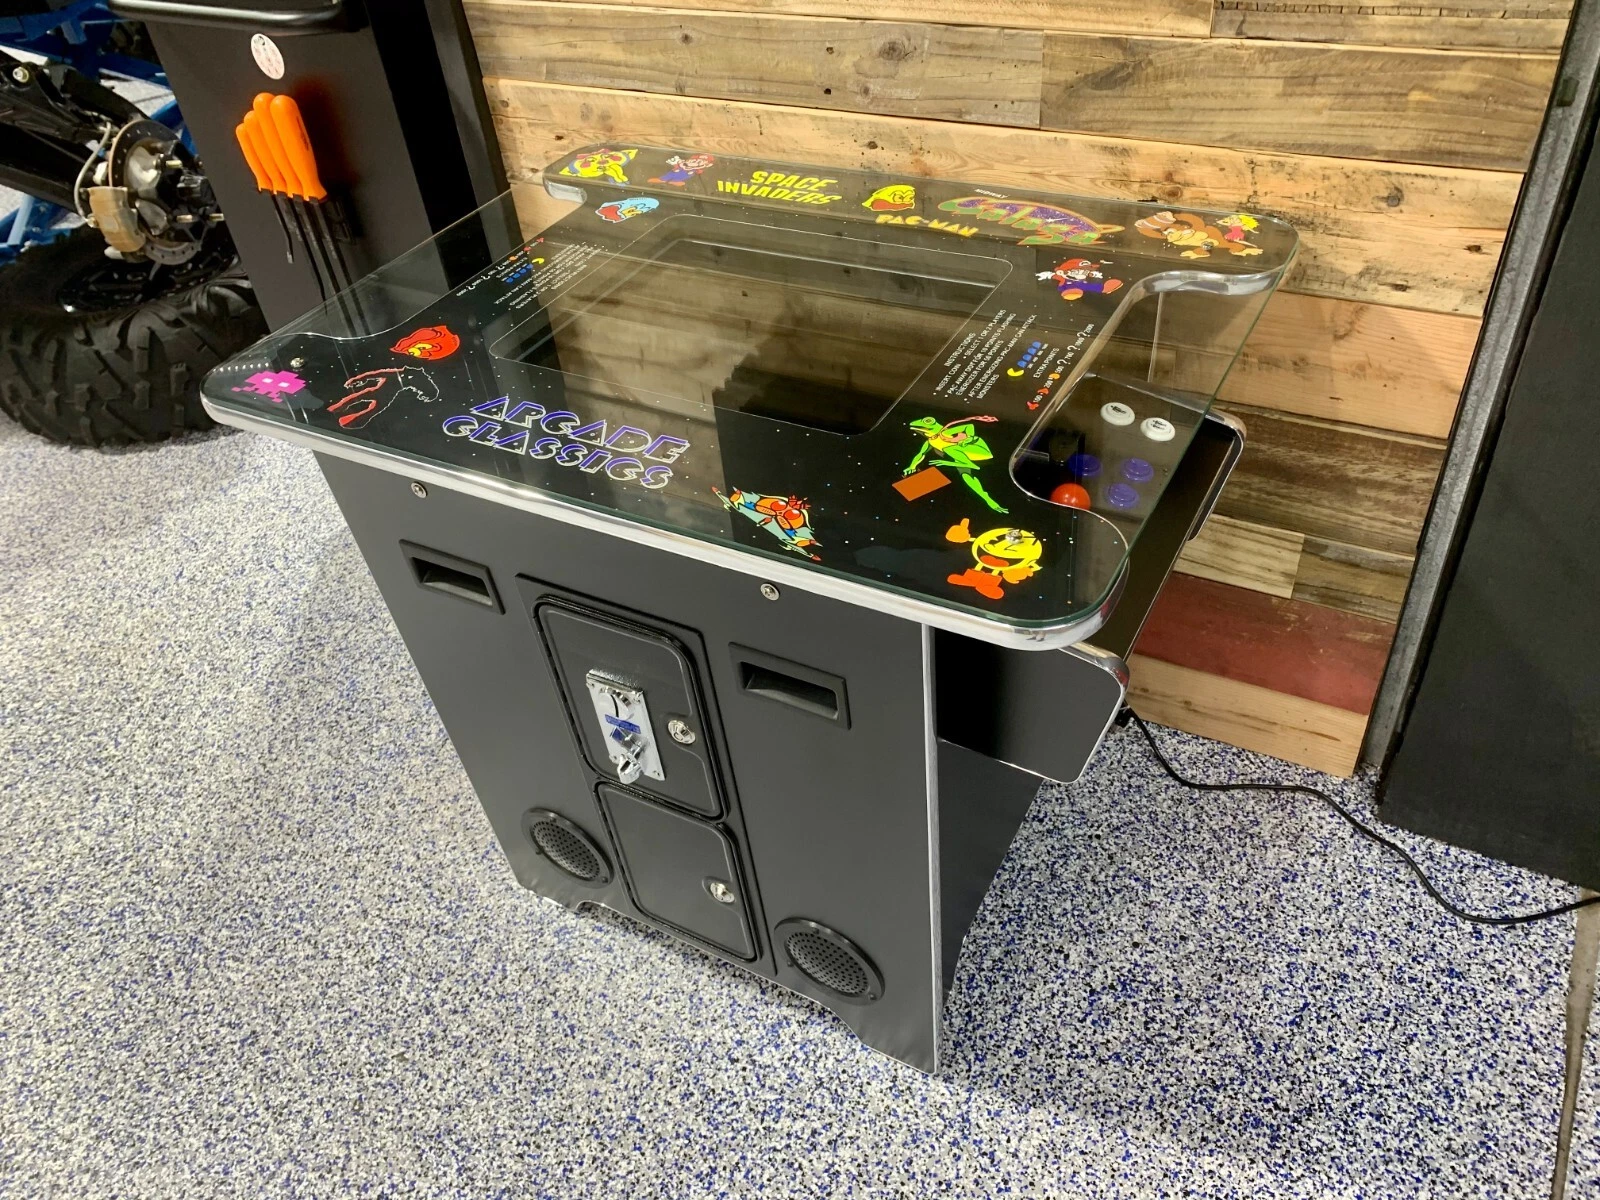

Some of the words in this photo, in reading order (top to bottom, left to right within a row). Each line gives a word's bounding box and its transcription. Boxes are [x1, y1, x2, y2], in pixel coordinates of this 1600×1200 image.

[717, 180, 842, 205] INVADERS
[750, 170, 838, 191] SPACE
[974, 188, 1009, 199] MIDWAY
[875, 214, 979, 237] PAC-MAN
[964, 339, 981, 355] SELECT
[988, 310, 1006, 327] PLAYERS
[944, 333, 976, 366] INSTRUCTIONS
[976, 361, 987, 370] FOR
[988, 340, 1004, 355] POINTS
[1033, 364, 1048, 378] EXTRA
[1044, 348, 1059, 363] POINTS
[947, 385, 958, 394] PAC
[965, 362, 975, 372] DOT
[985, 333, 1000, 347] POINTS
[936, 375, 951, 391] INSERT
[968, 382, 983, 397] AFTER
[977, 374, 999, 398] MONSTERS
[469, 395, 691, 464] ARCADE
[442, 415, 673, 489] CLASSICS
